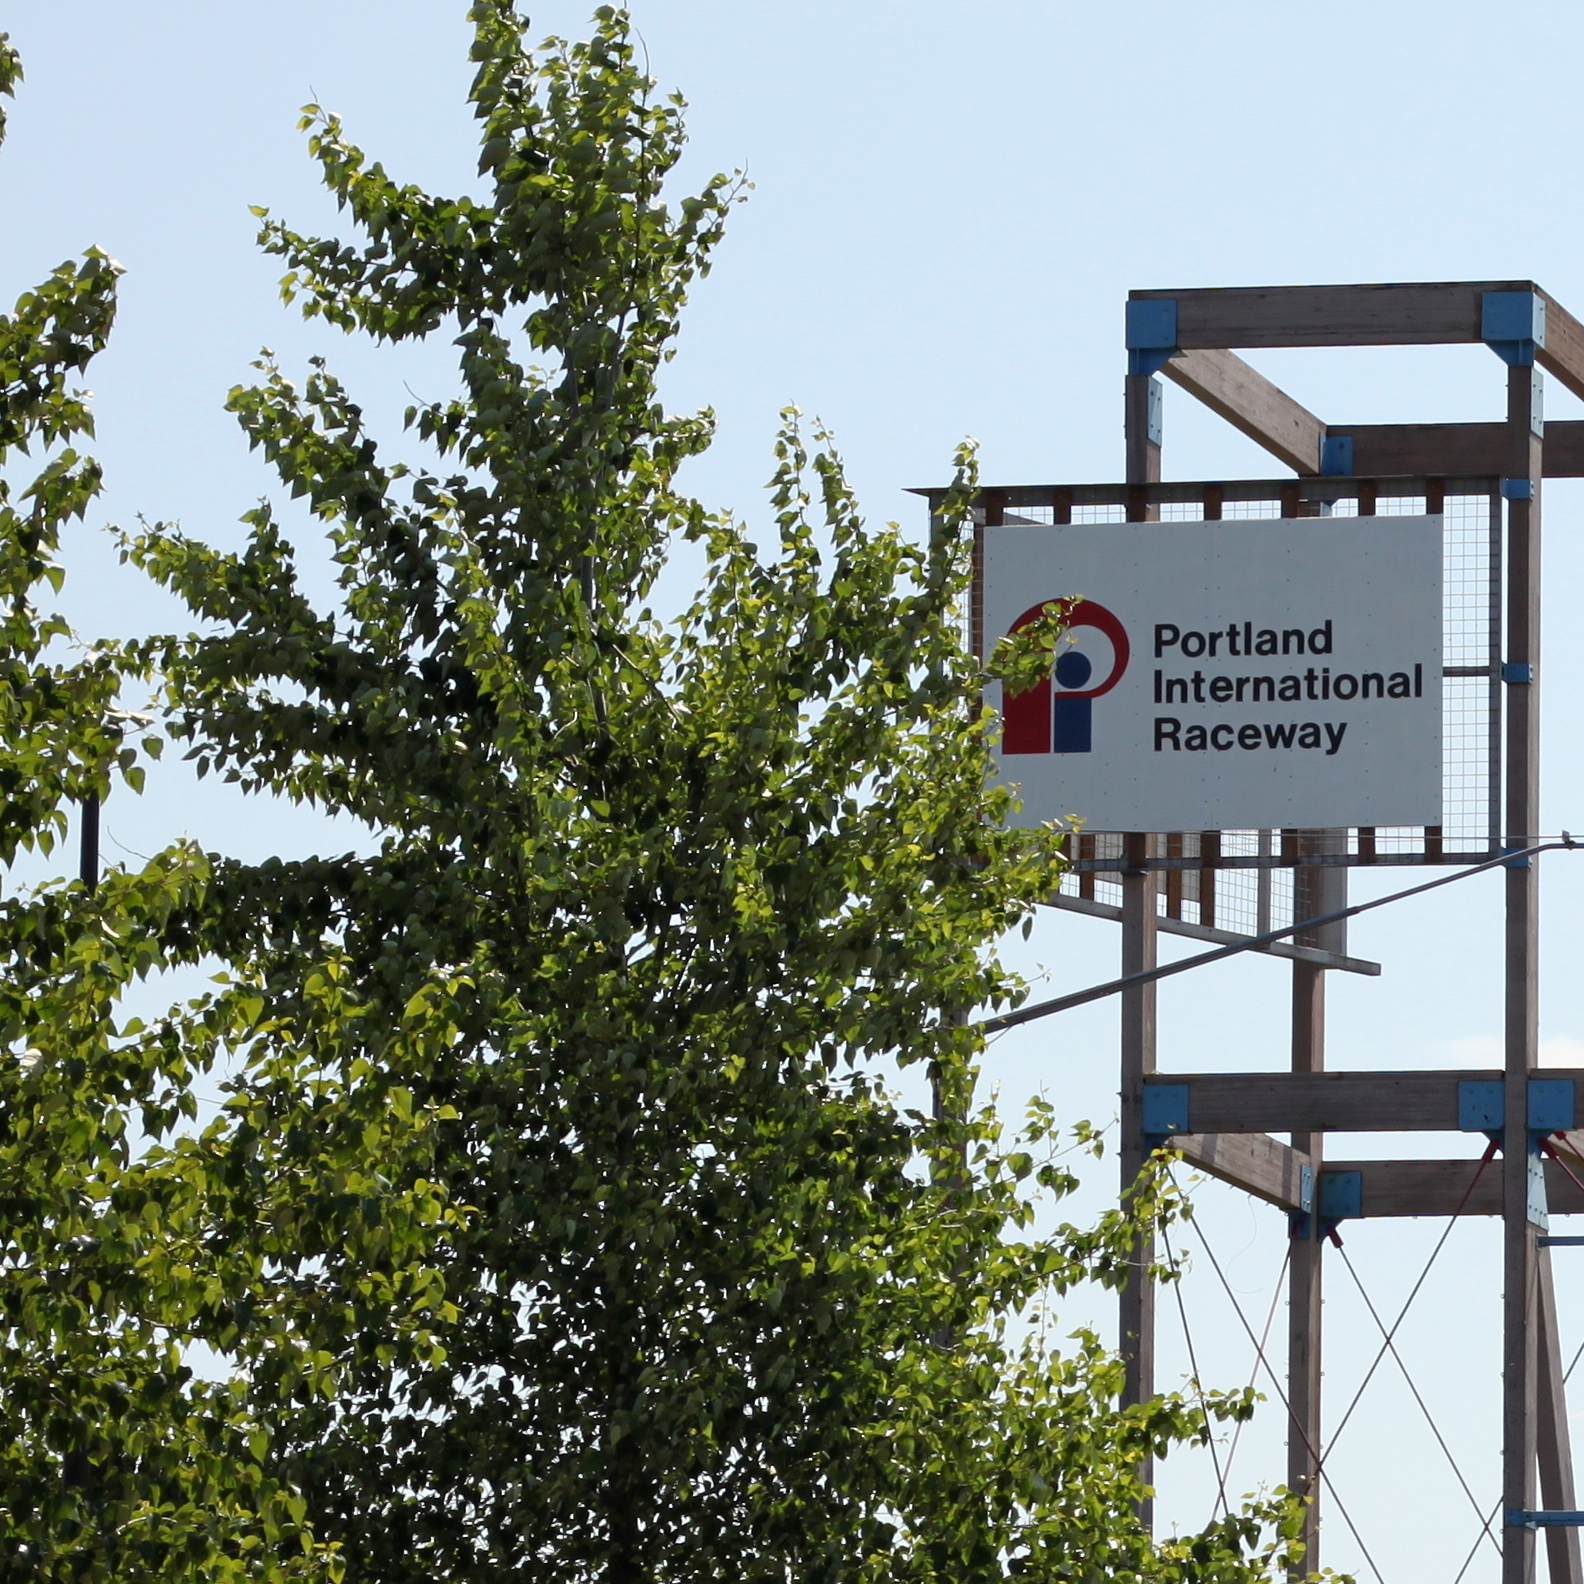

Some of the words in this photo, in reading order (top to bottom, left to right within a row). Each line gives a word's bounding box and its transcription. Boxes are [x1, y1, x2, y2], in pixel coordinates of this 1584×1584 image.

[1154, 619, 1333, 658] Portland
[1154, 662, 1423, 703] International
[1154, 716, 1348, 755] Raceway
